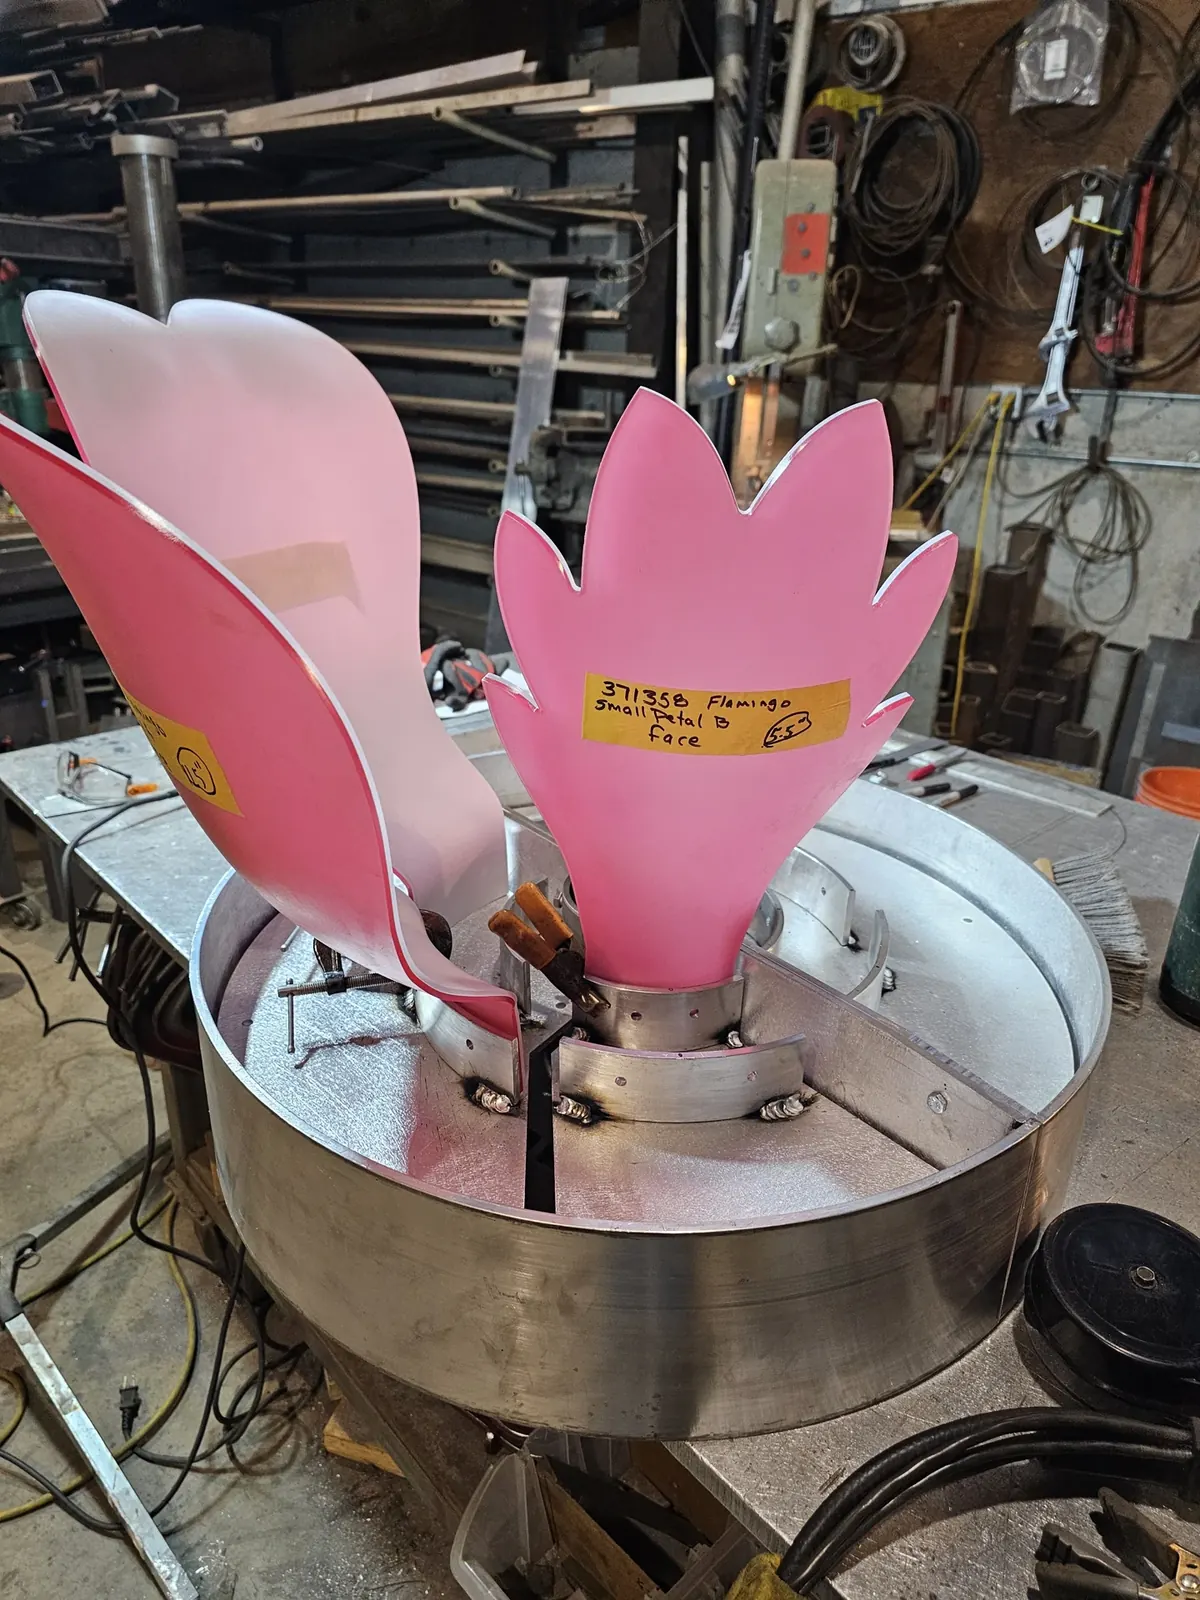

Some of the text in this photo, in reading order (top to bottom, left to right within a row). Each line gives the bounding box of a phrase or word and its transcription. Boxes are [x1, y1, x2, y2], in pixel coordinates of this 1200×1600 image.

[601, 680, 791, 712] 371358 Flamingo
[650, 707, 703, 729] Petal
[714, 715, 730, 729] B
